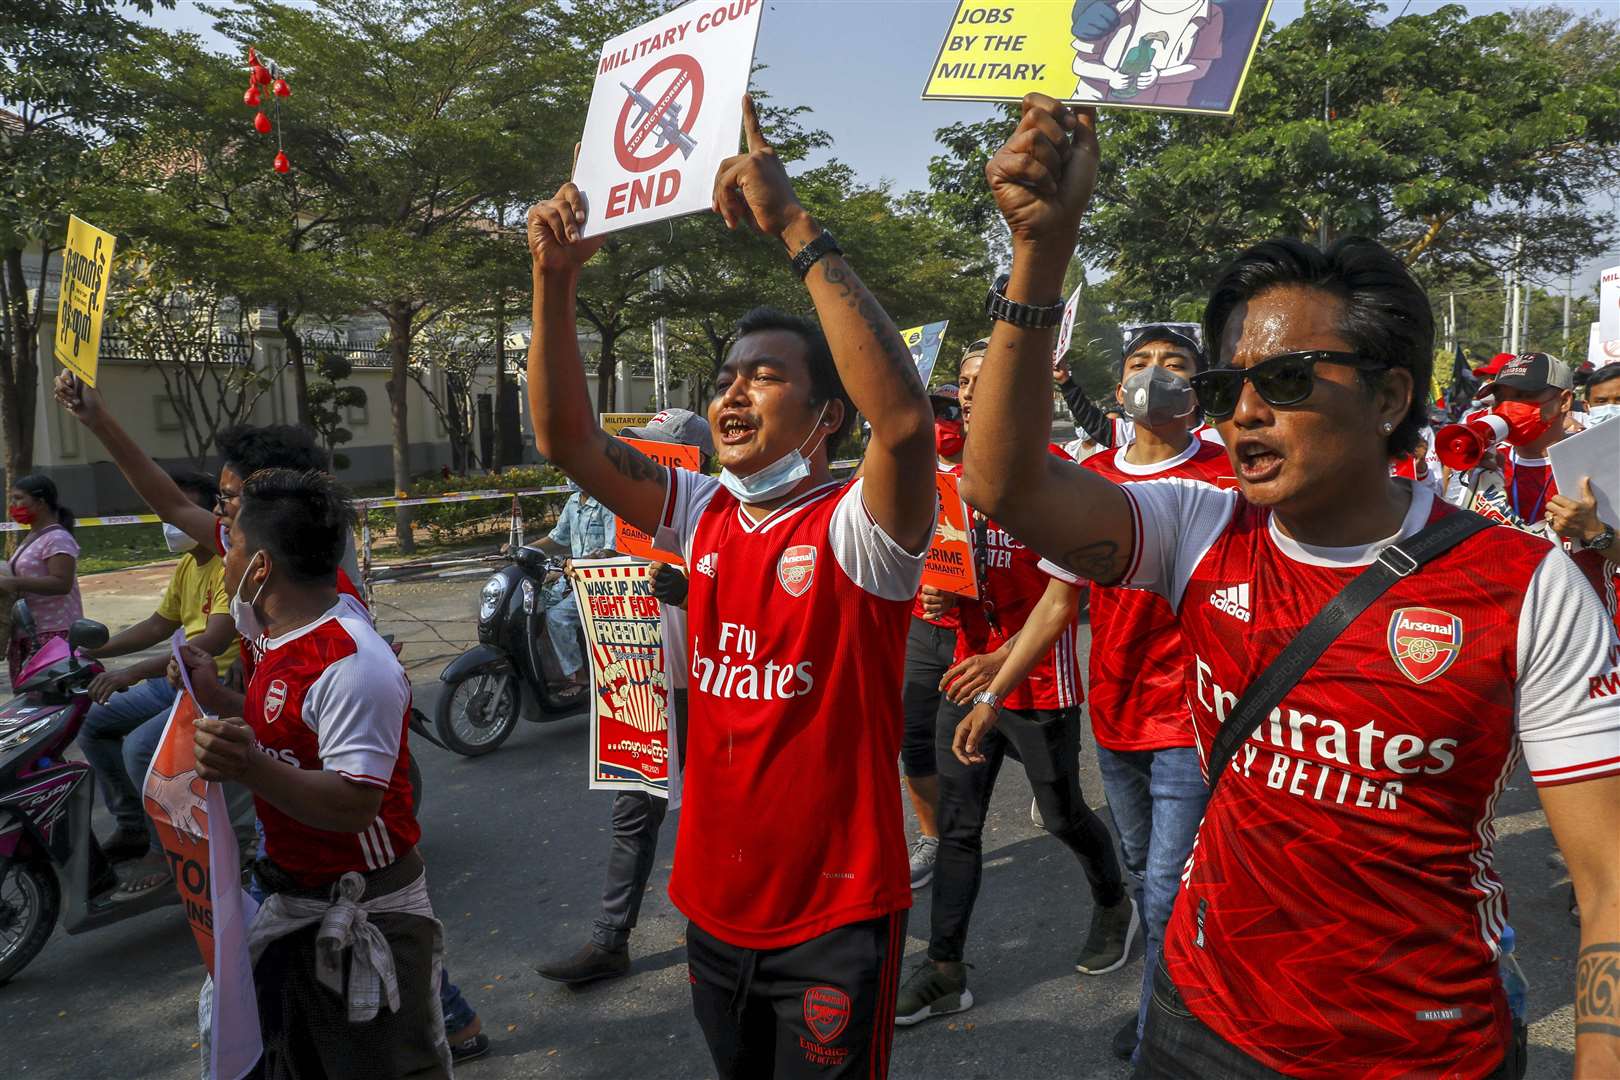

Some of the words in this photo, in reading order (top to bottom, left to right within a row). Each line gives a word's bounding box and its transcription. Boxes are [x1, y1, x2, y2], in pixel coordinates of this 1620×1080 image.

[957, 8, 1014, 24] JOBS
[599, 21, 692, 75] MILITARY
[696, 0, 759, 33] COUP
[949, 36, 978, 51] BY
[984, 35, 1027, 51] THE
[937, 63, 1046, 80] MILITARY.
[627, 130, 643, 153] STOP
[643, 71, 689, 131] DICTATORSHIP
[605, 169, 681, 219] END
[1602, 272, 1620, 283] MIL
[621, 527, 652, 542] AGAINS
[783, 553, 812, 564] Arsenal
[926, 547, 963, 566] CRIME
[584, 580, 613, 596] WAKE
[615, 580, 628, 596] UP
[588, 595, 626, 619] FIGHT
[628, 596, 660, 619] FOR
[1210, 592, 1251, 623] adidas
[1400, 618, 1452, 636] Arsenal
[719, 622, 756, 660] Fly
[692, 635, 814, 700] Eirates
[1588, 671, 1620, 699] RW
[1266, 752, 1403, 811] BETTER
[165, 849, 210, 900] TO
